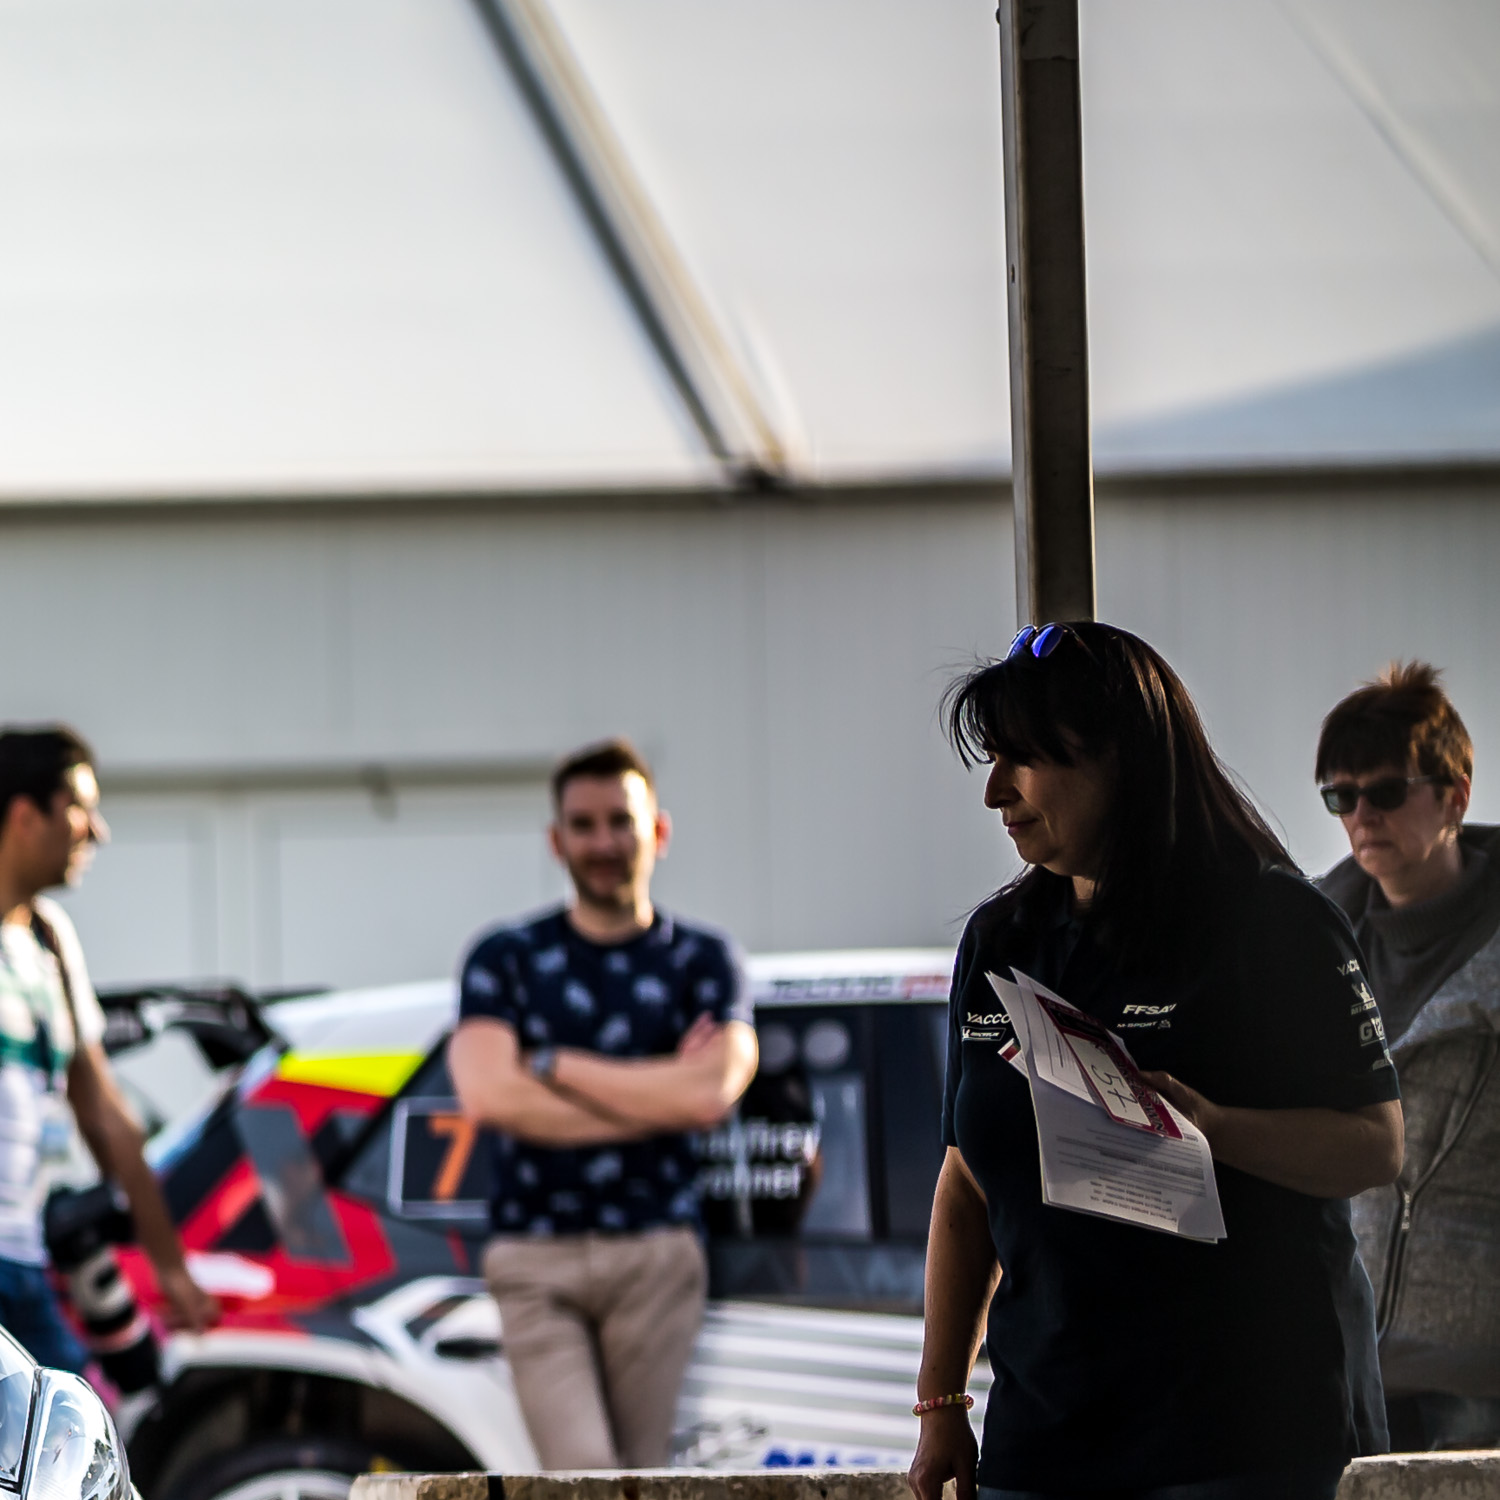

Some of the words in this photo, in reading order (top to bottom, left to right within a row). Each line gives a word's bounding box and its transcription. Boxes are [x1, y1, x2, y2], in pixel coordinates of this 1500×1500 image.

[967, 1011, 1011, 1025] YACCO
[1122, 1004, 1170, 1015] FFSA
[1091, 1064, 1138, 1109] 57
[427, 1113, 478, 1203] 7
